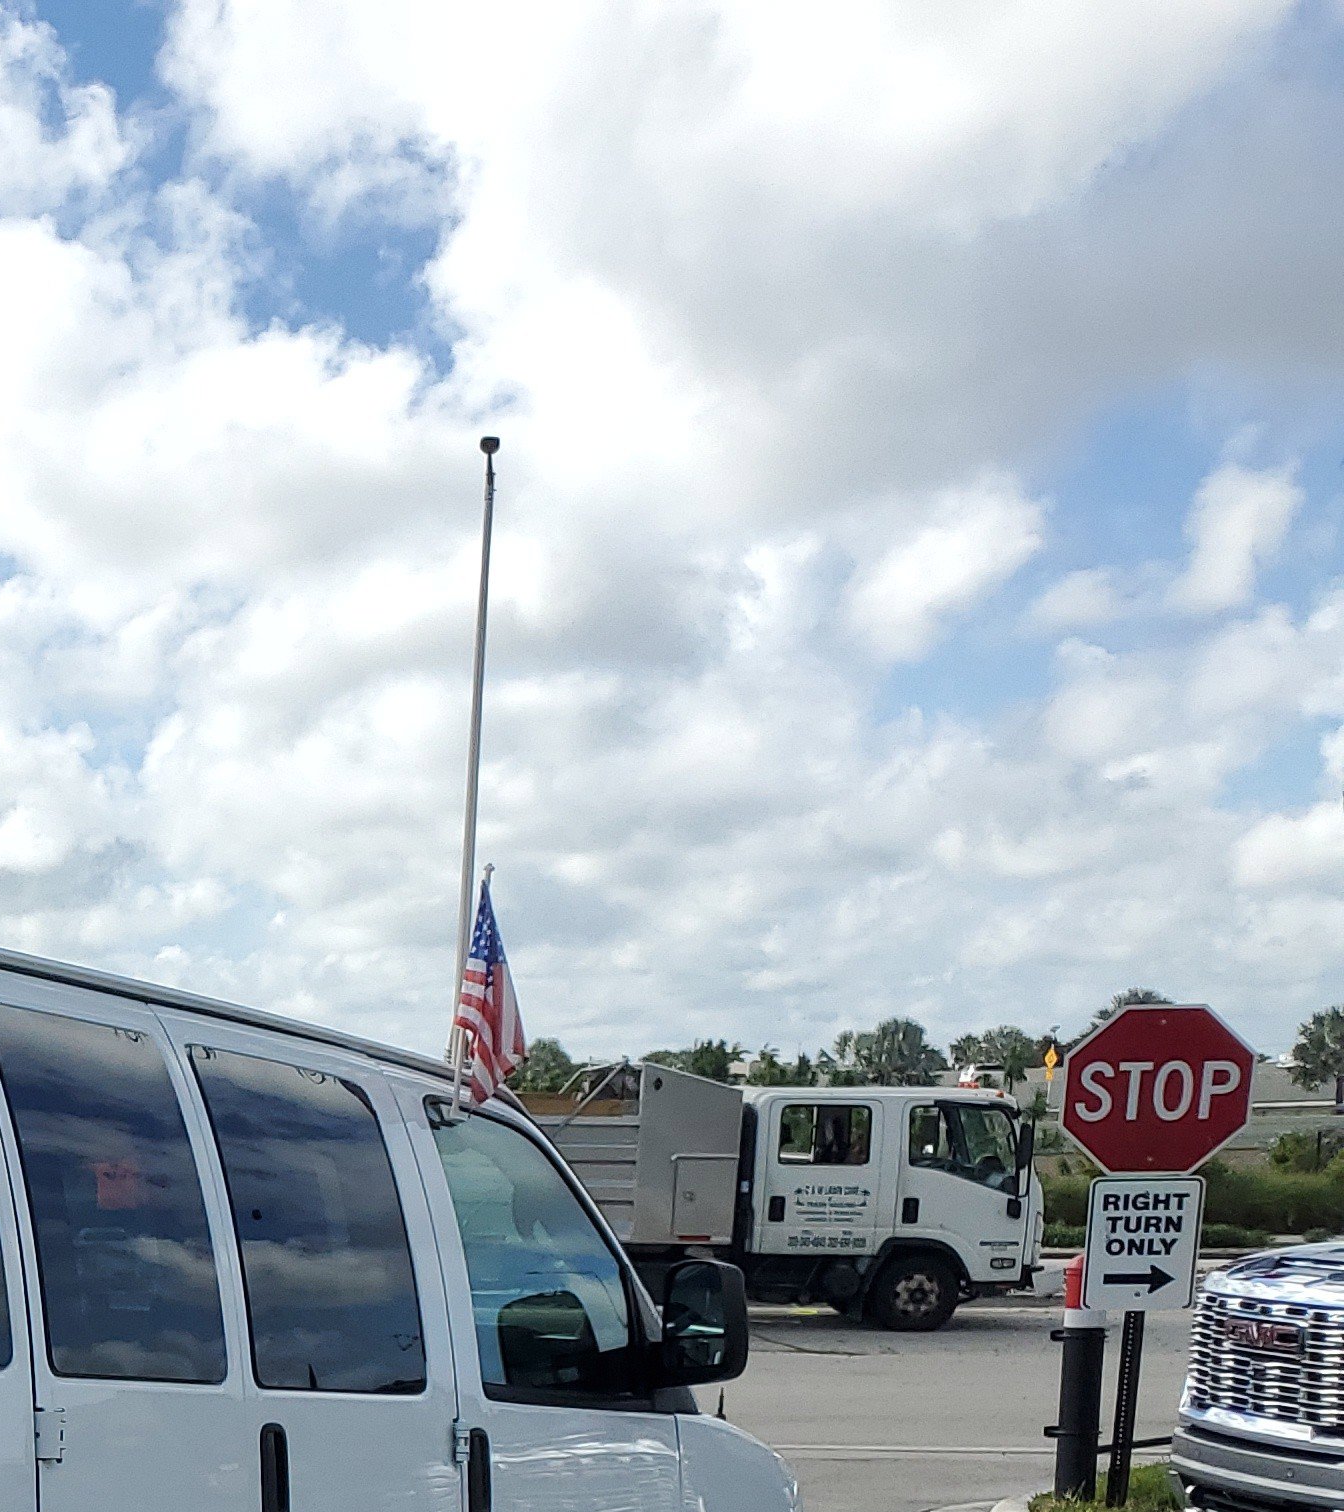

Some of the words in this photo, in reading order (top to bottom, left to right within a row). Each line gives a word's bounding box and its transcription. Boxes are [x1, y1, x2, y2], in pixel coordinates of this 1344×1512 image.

[1074, 1060, 1241, 1123] STOP
[1103, 1193, 1191, 1212] RIGHT
[1105, 1215, 1183, 1234] TURN
[1105, 1238, 1179, 1256] ONLY
[1224, 1319, 1301, 1353] GMC
